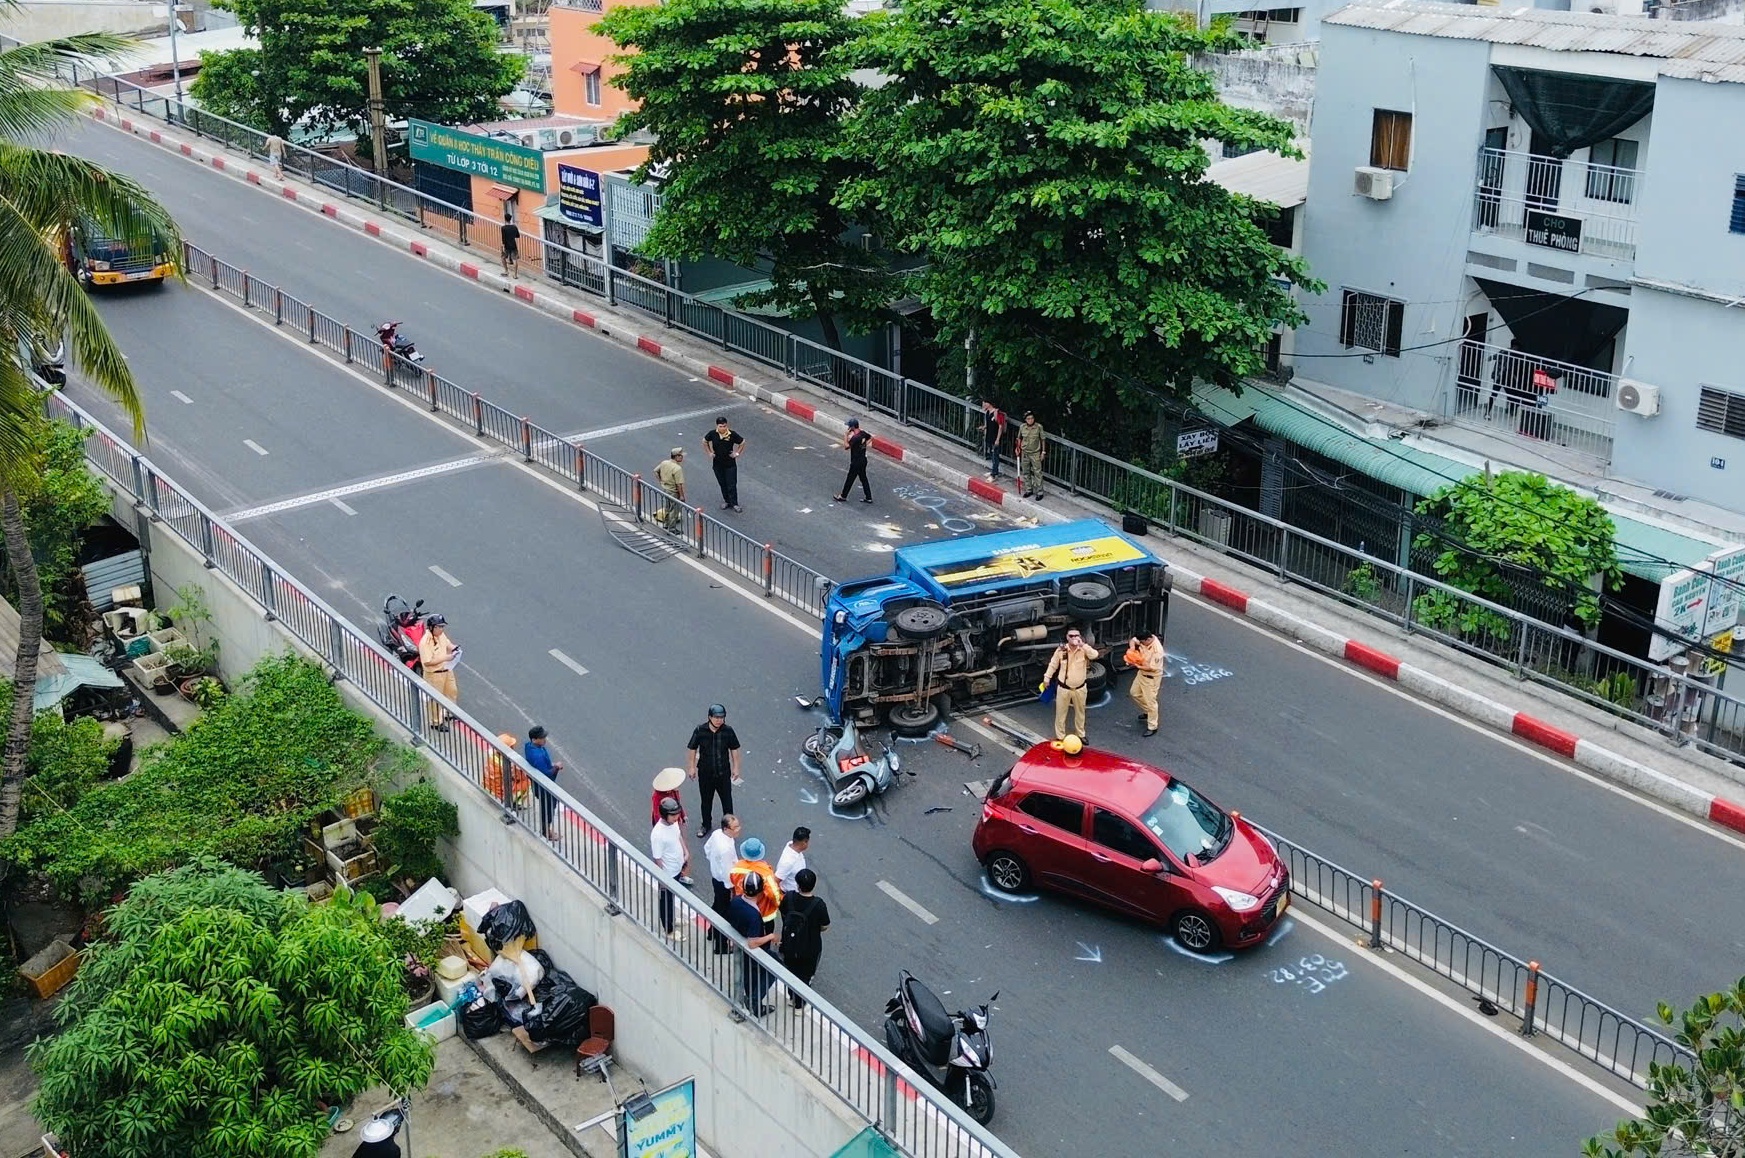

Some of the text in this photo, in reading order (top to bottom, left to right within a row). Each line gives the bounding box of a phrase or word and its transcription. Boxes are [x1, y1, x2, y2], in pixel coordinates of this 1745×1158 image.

[490, 166, 498, 176] 12
[1543, 217, 1566, 230] CHO
[1528, 229, 1578, 250] THUÊ PHÒNG
[636, 1122, 685, 1151] YUMMY
